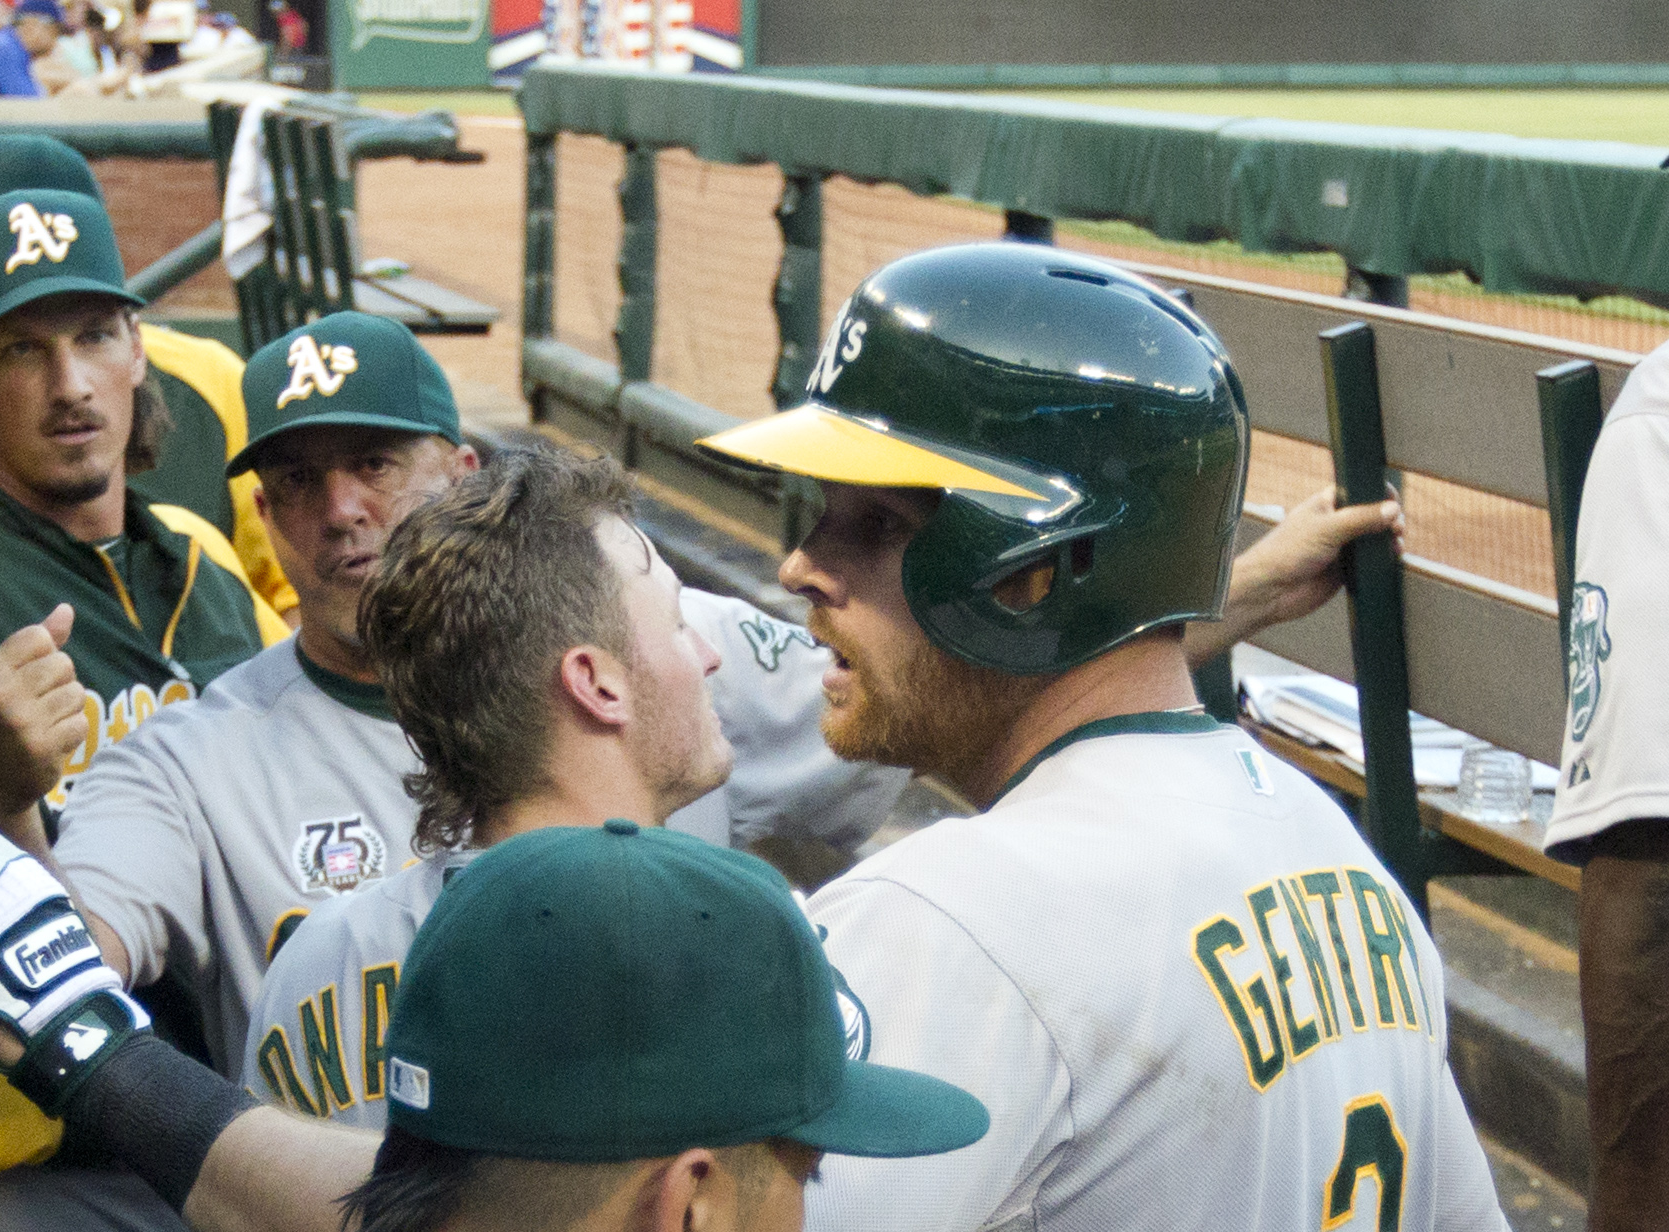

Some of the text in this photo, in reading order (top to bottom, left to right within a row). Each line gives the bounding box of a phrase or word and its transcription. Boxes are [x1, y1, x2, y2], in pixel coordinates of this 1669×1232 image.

[5, 202, 79, 275] A's
[276, 334, 359, 410] A's
[305, 816, 370, 870] 75
